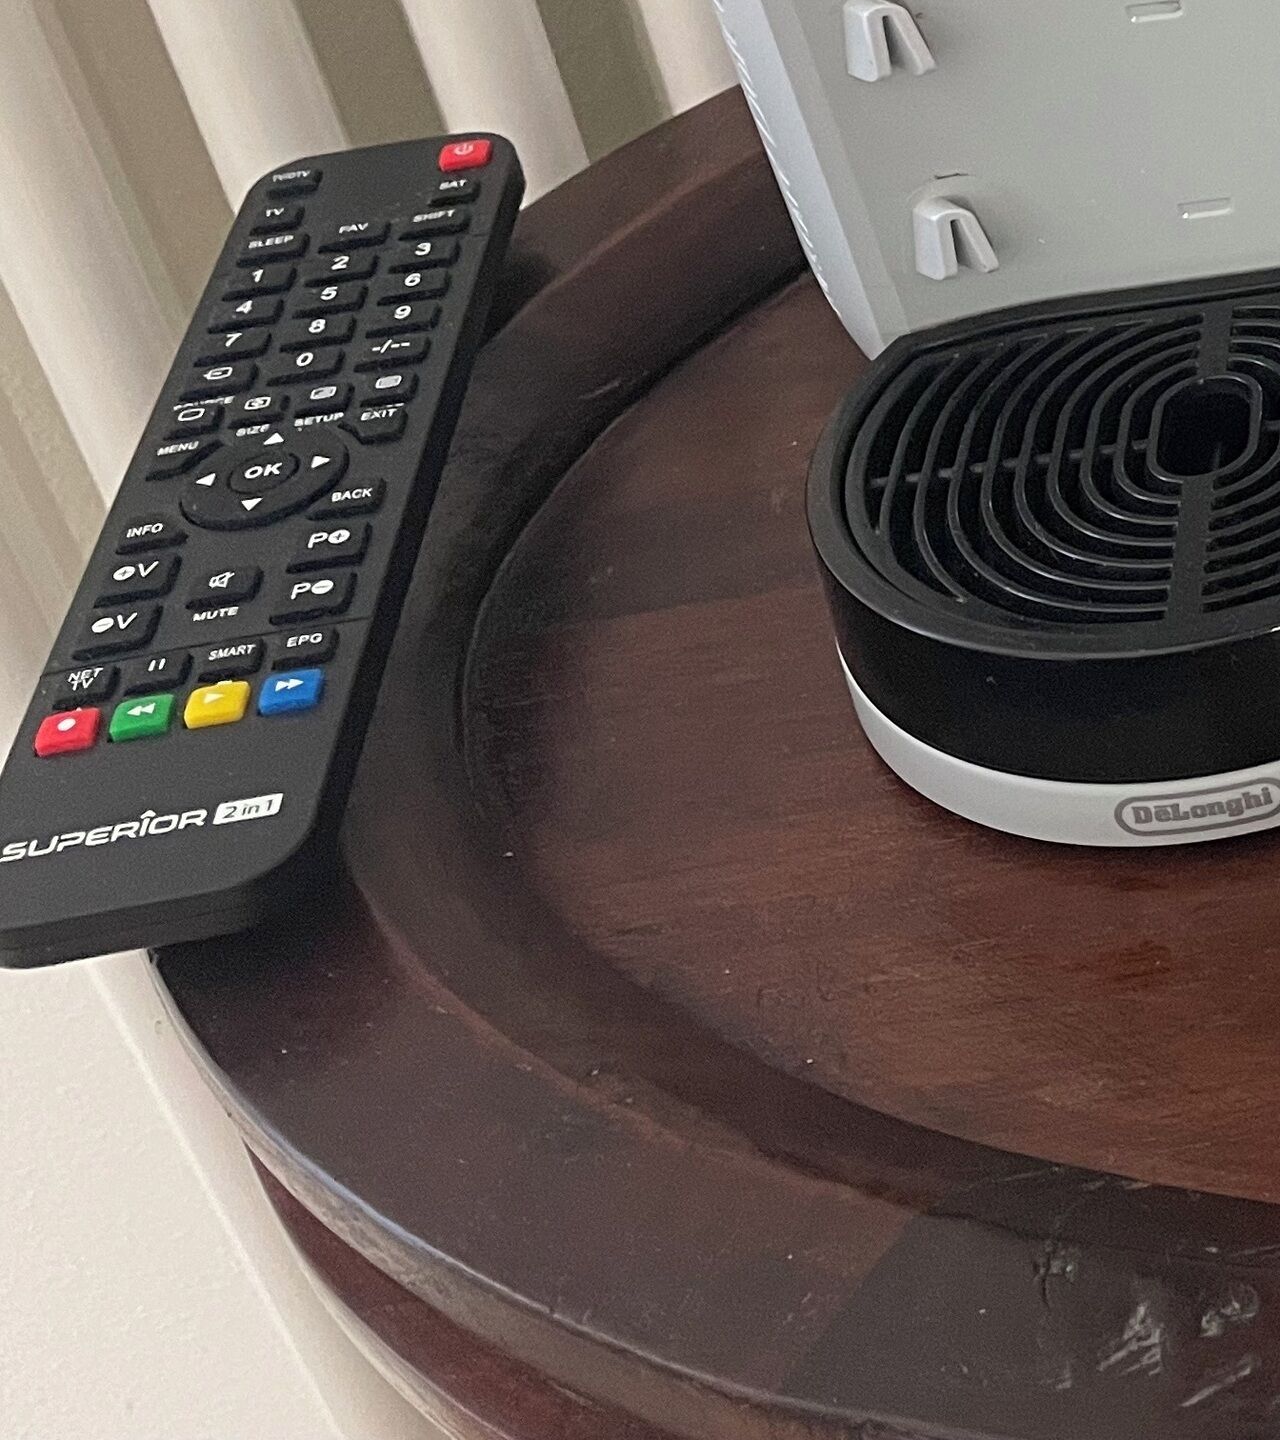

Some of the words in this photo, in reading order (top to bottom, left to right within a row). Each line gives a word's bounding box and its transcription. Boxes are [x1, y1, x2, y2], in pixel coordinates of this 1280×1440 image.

[248, 235, 294, 249] SLEEP
[414, 242, 432, 256] 3
[331, 256, 350, 270] 2
[252, 269, 264, 283] 1
[404, 272, 421, 287] 6
[320, 286, 338, 301] 5
[236, 300, 253, 314] 4
[394, 305, 412, 320] 9
[308, 318, 326, 334] 8
[225, 332, 242, 347] 7
[296, 352, 314, 367] 0
[294, 412, 345, 427] SETUP
[360, 408, 398, 421] EXIT
[157, 440, 199, 456] MENU
[244, 462, 283, 479] OK
[331, 487, 373, 503] BACK
[126, 522, 164, 538] INFO
[192, 606, 239, 622] MUTE
[286, 633, 323, 648] EPG
[208, 644, 256, 660] SMART
[67, 667, 104, 682] NET
[72, 677, 96, 691] TV
[224, 805, 238, 820] 2
[241, 803, 259, 816] in
[265, 799, 275, 812] 1
